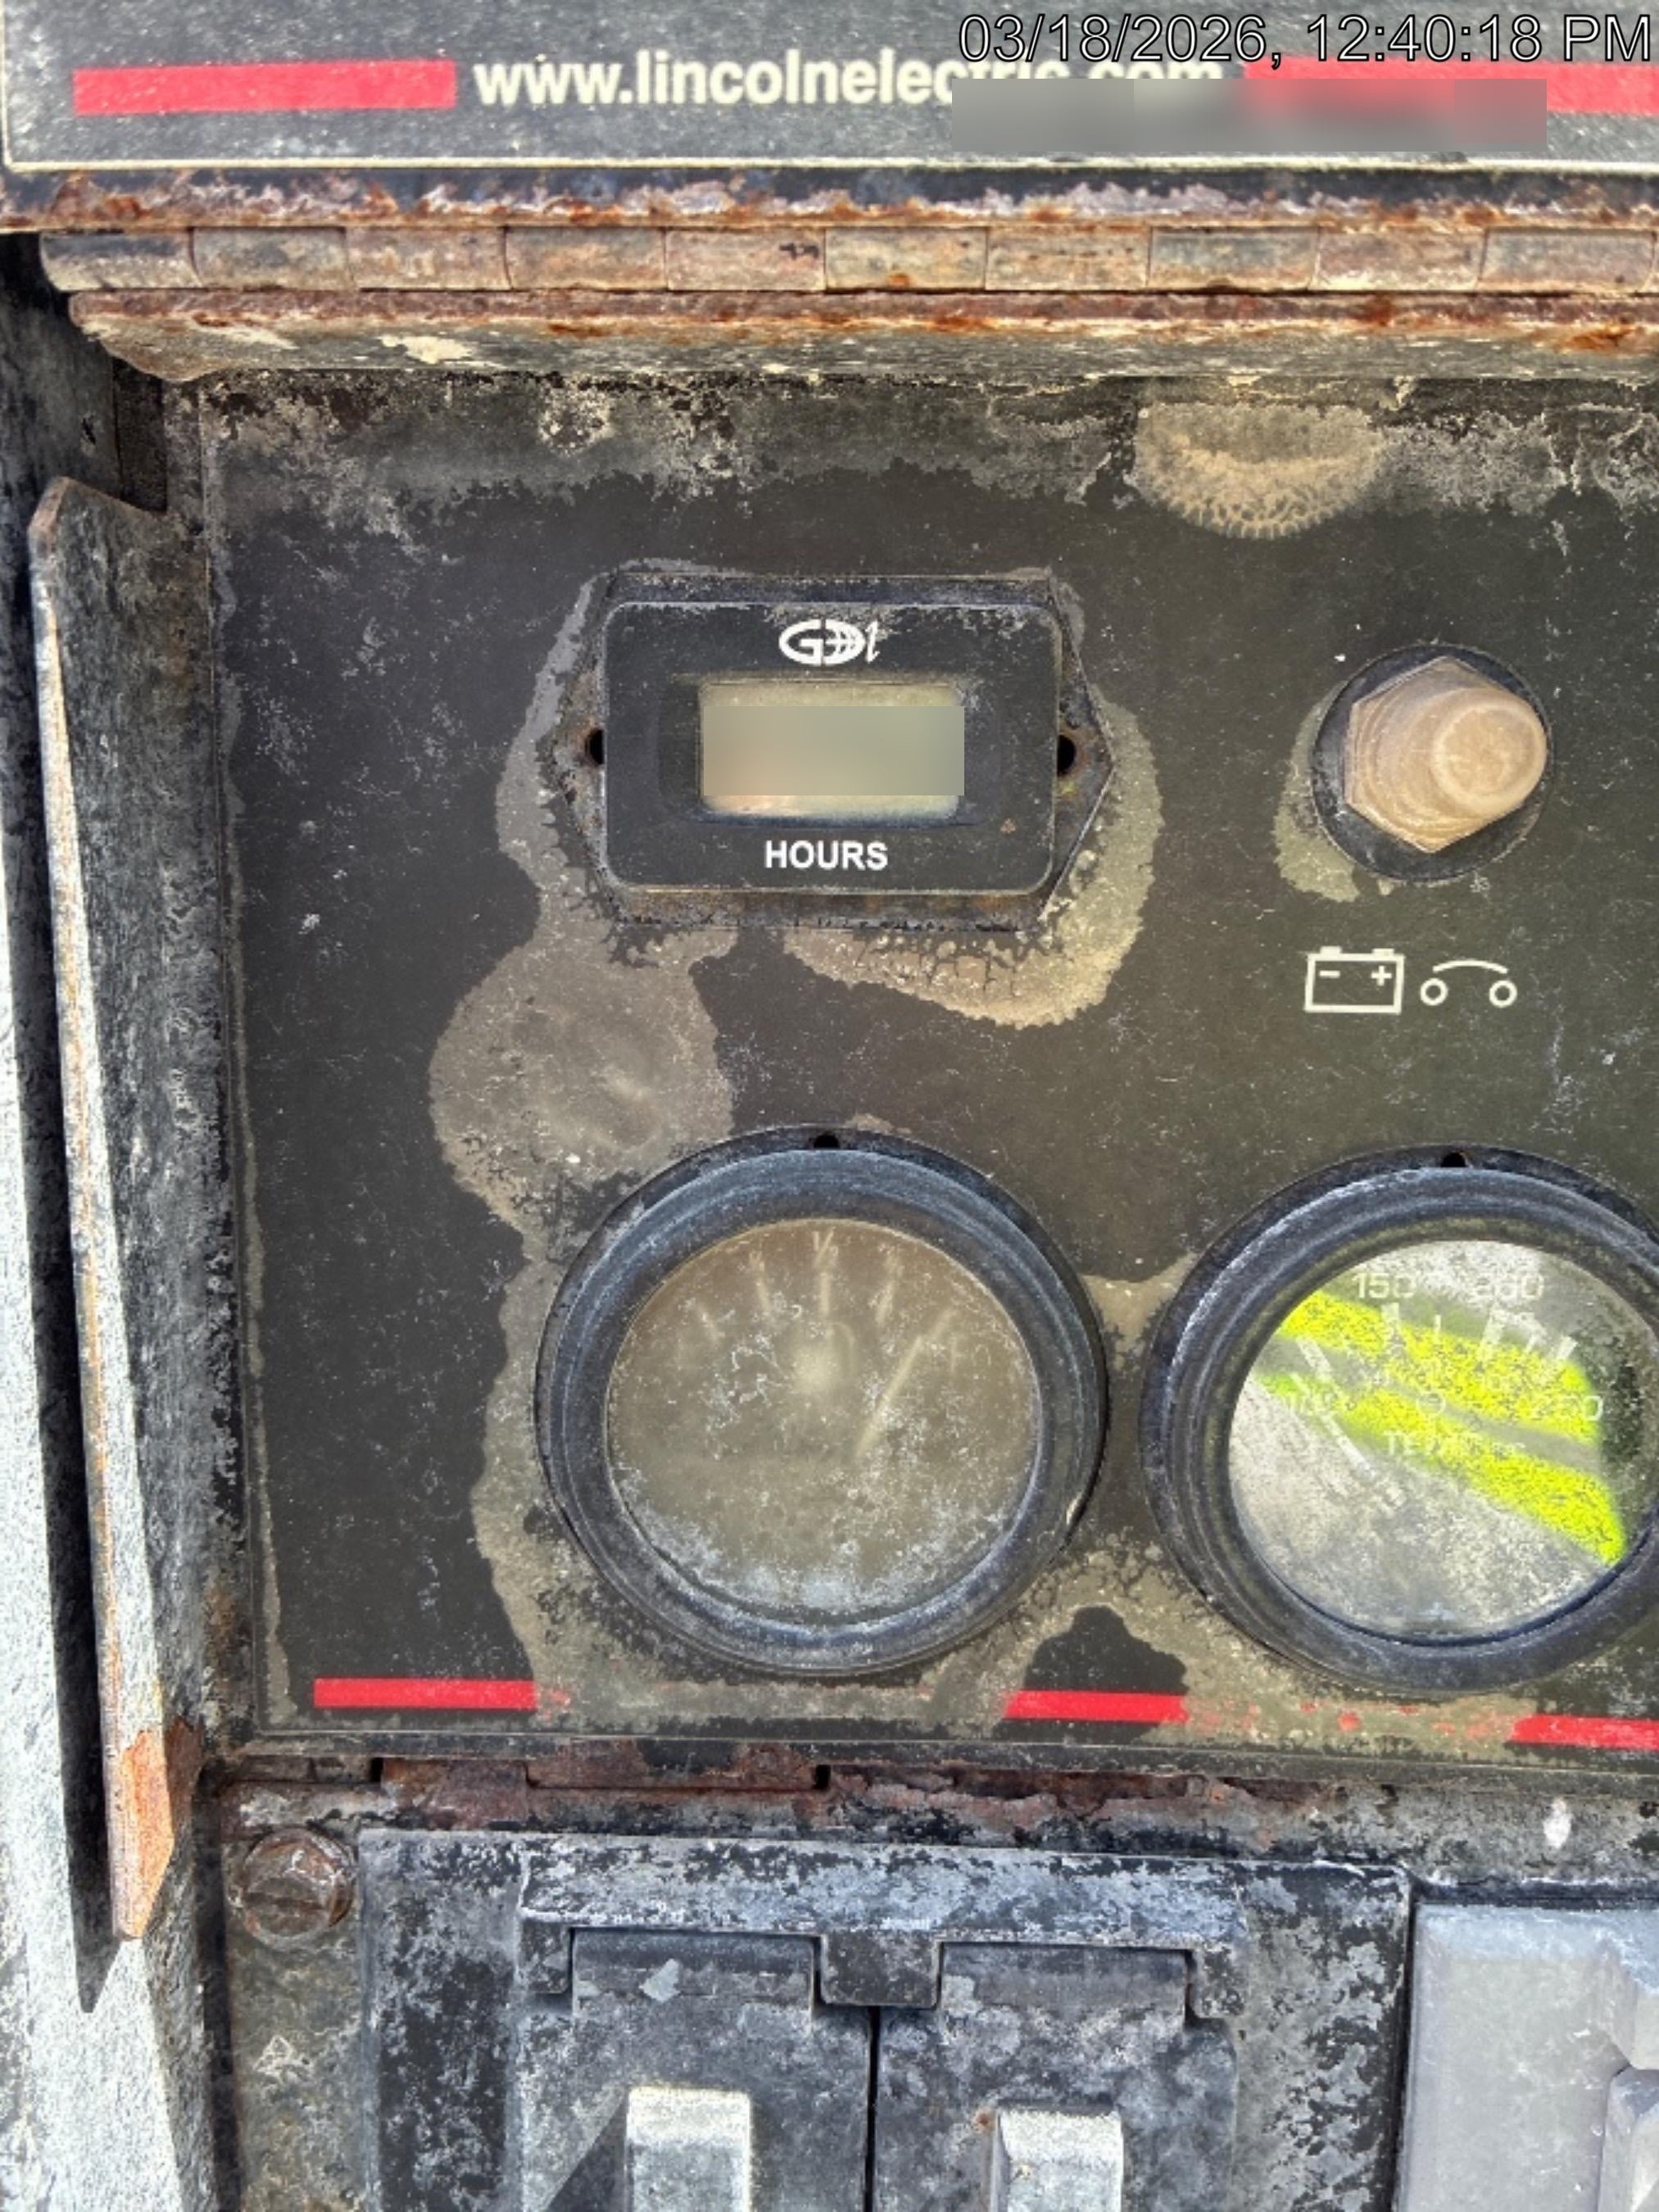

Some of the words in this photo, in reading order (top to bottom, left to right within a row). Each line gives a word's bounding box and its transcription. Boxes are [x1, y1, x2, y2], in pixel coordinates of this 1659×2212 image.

[473, 46, 1222, 106] www.lincolnelec
[764, 840, 888, 870] HOURS
[1352, 1271, 1417, 1299] 150
